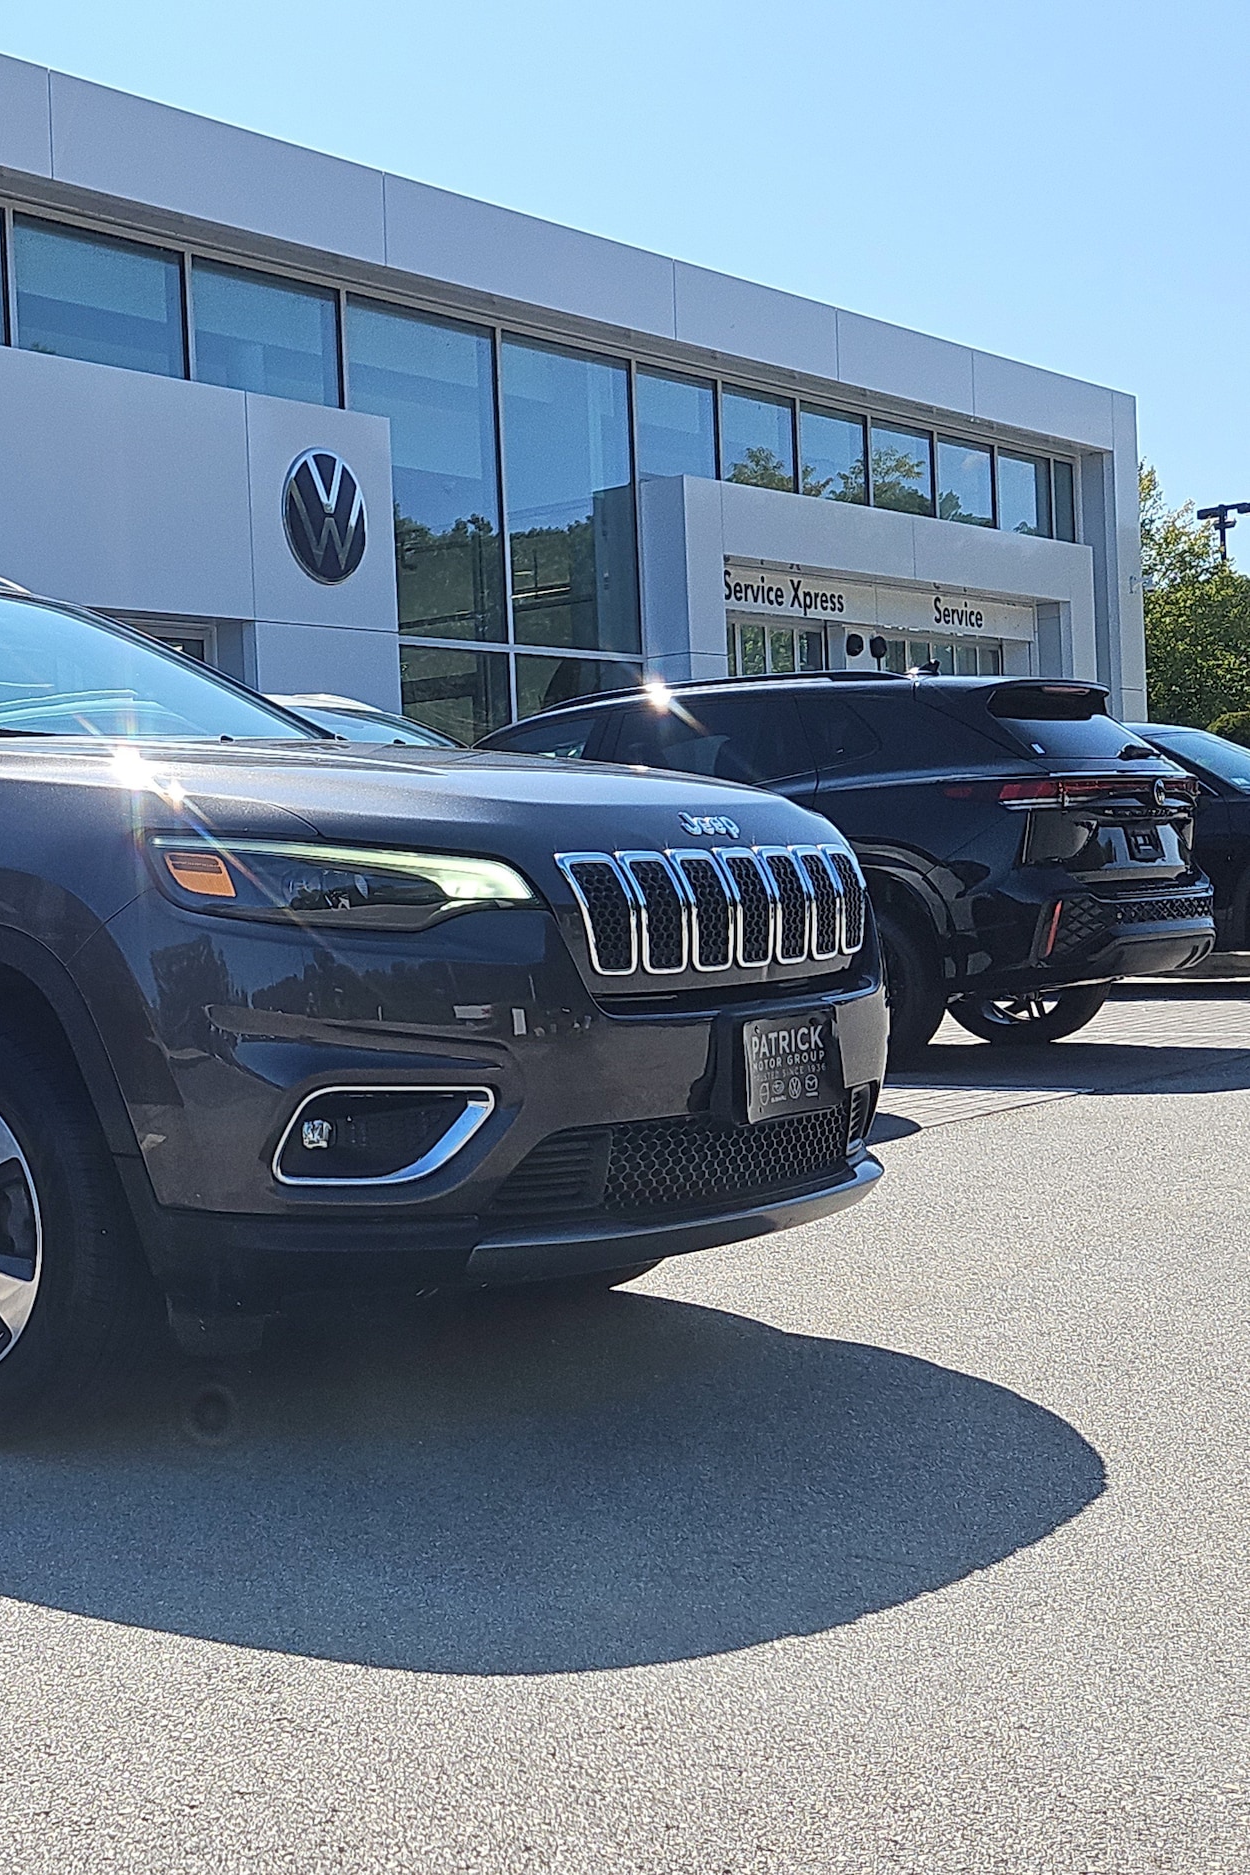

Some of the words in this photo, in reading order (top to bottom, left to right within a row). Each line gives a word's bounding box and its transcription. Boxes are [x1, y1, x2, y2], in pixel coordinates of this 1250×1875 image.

[724, 569, 785, 607] Service
[789, 579, 844, 617] Xpress
[933, 596, 983, 628] Service
[677, 811, 741, 839] Jeep
[752, 1025, 824, 1060] PATRICK
[752, 1057, 782, 1073] MOTOR
[787, 1051, 825, 1065] GROUP
